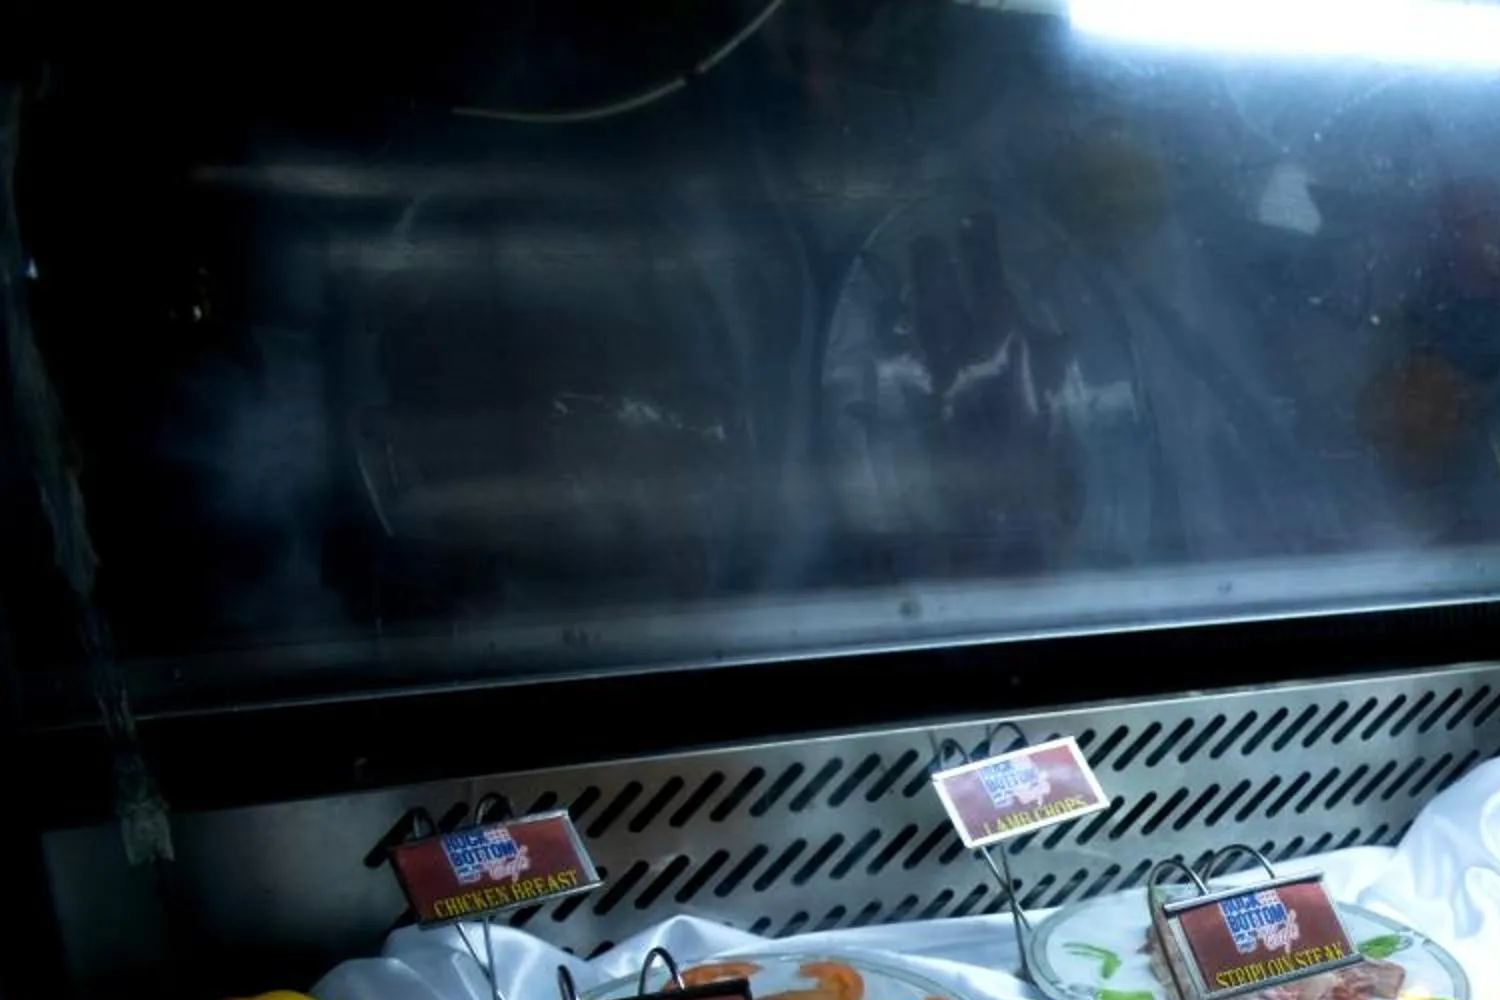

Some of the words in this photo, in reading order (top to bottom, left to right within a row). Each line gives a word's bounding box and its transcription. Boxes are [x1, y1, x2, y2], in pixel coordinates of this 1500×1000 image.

[450, 840, 517, 866] BOTTOM
[433, 884, 509, 918] CHICKEN
[512, 868, 578, 901] BREAST
[1228, 903, 1288, 932] BOTTOM
[1293, 941, 1345, 969] STEAK
